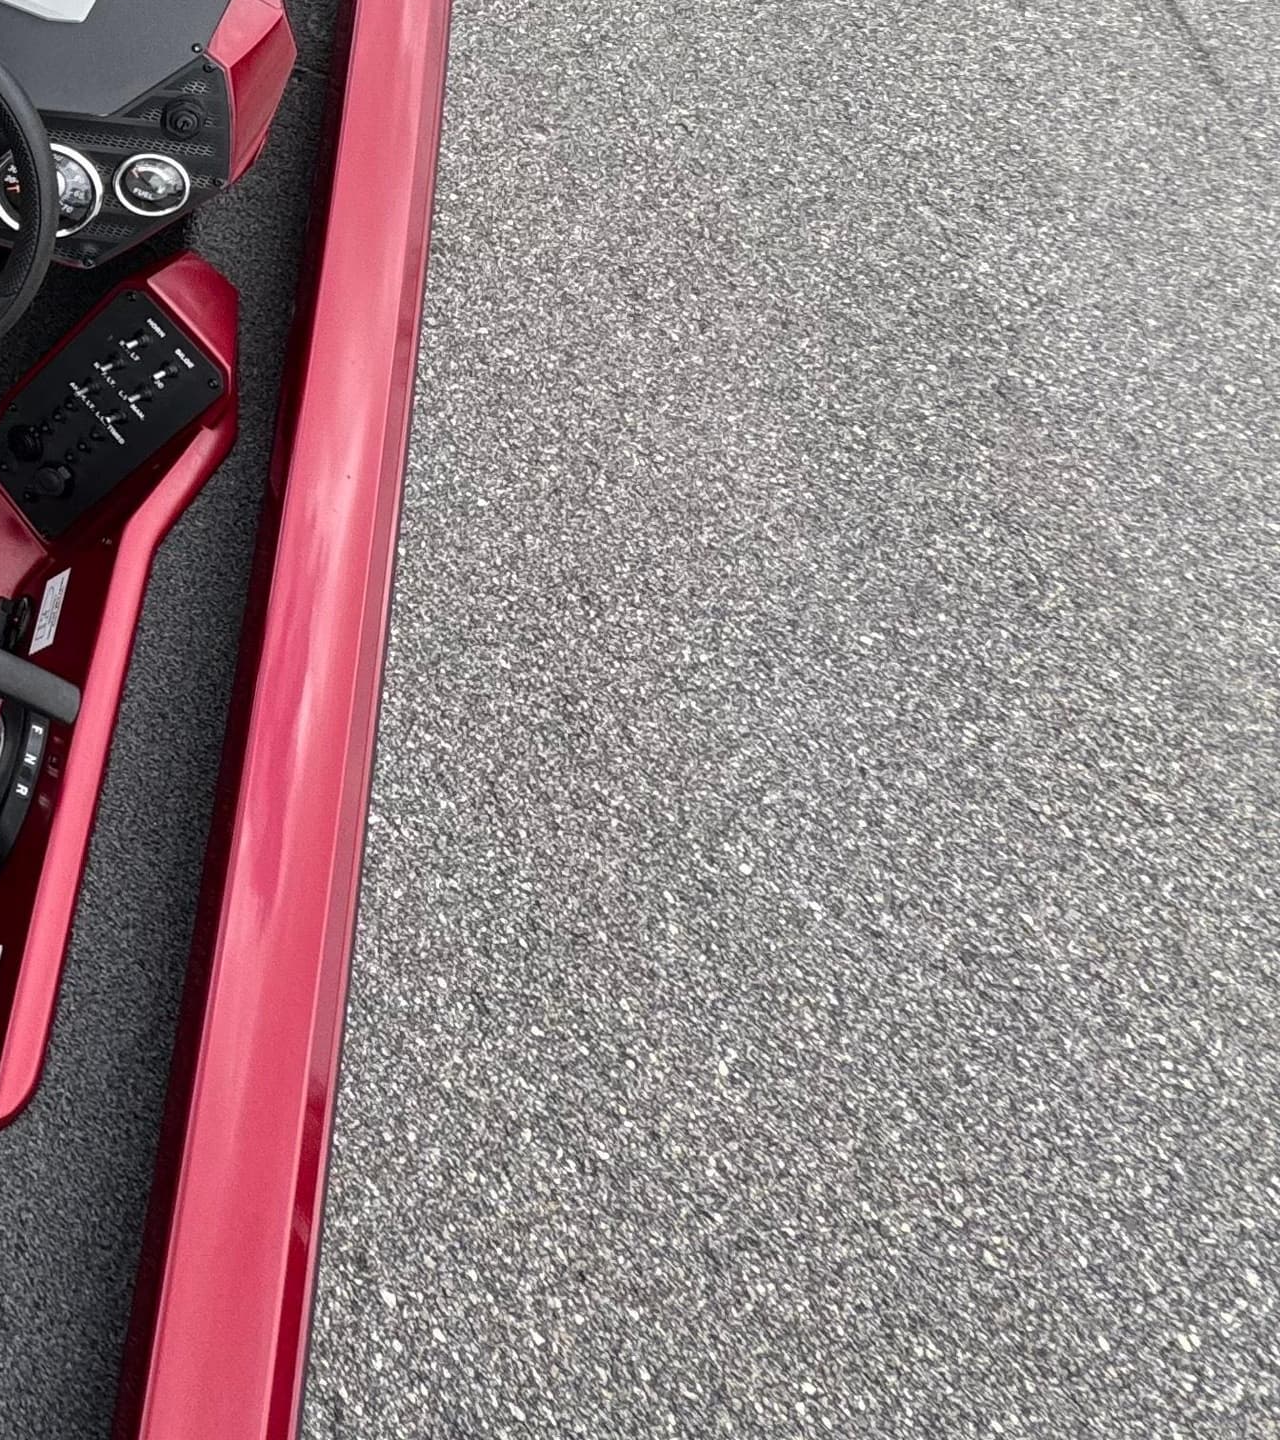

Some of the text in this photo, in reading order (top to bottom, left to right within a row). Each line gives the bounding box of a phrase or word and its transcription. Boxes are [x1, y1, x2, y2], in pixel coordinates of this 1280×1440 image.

[15, 724, 44, 796] F N R
